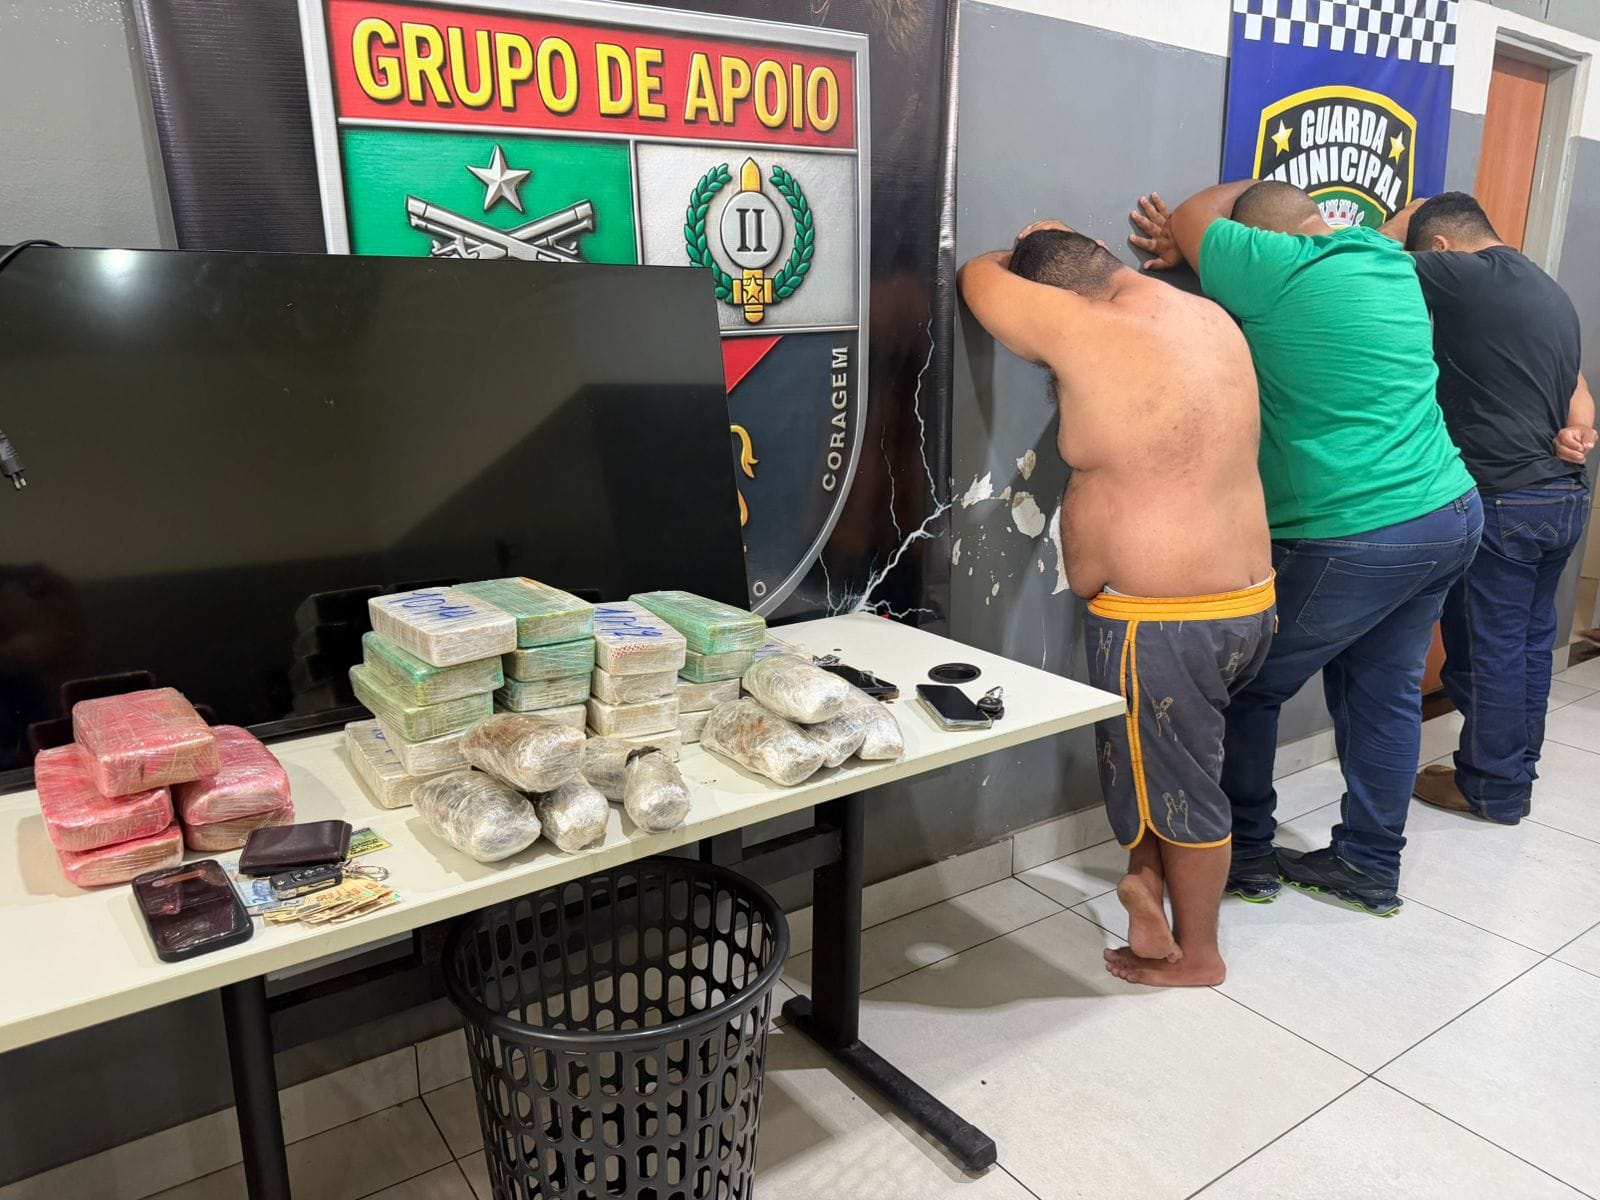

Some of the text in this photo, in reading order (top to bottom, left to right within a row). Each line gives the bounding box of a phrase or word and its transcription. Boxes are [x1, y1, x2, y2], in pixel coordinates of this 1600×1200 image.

[352, 17, 840, 132] GRUPO DE APOIO
[1300, 105, 1388, 155] GUARDA
[735, 208, 768, 252] II
[822, 346, 848, 492] CORAGEM
